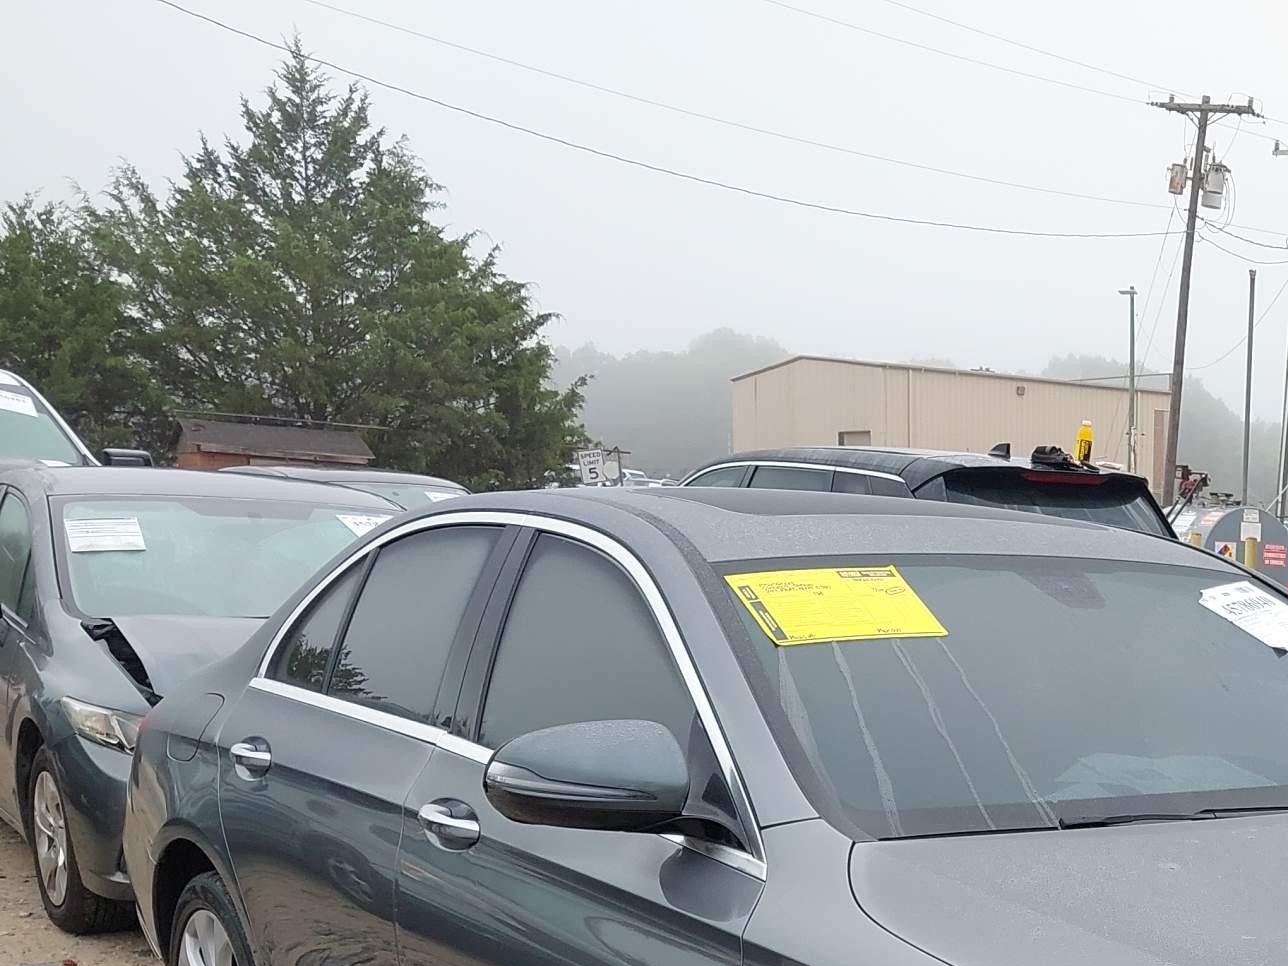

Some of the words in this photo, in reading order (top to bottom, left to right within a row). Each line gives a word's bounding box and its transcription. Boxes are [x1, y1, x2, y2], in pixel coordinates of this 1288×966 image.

[581, 451, 601, 459] SPEED
[583, 459, 600, 467] LIMIT
[588, 466, 599, 480] 5
